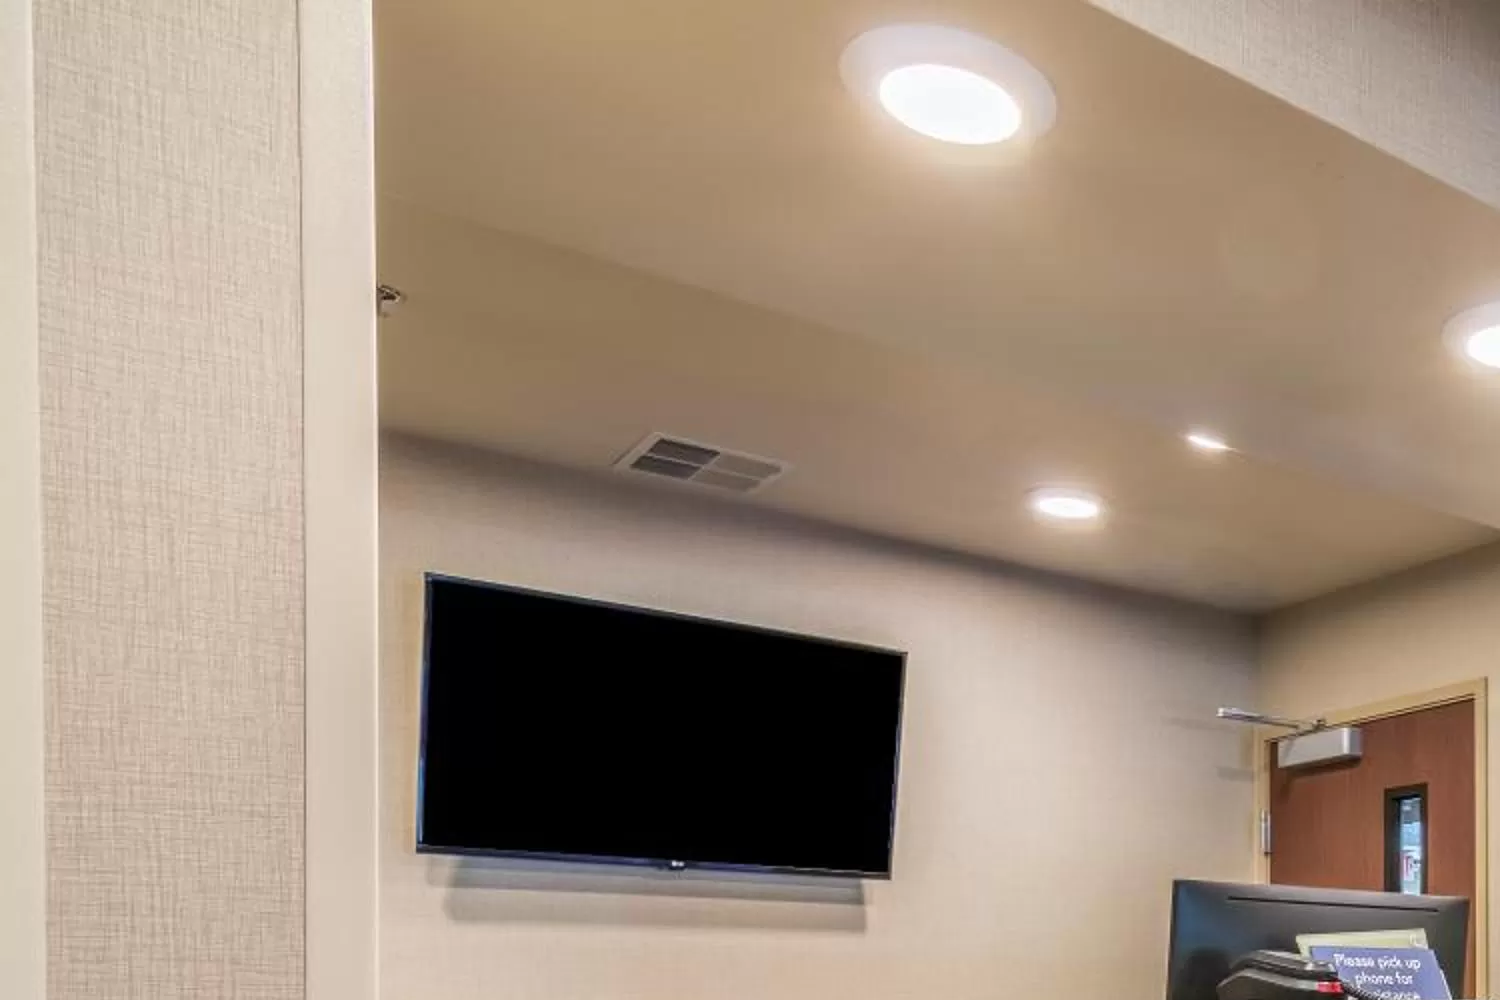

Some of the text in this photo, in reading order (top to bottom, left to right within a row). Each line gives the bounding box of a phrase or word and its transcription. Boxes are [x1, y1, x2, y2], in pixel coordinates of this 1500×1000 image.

[1333, 953, 1422, 973] Please pick up
[1355, 970, 1414, 987] phone for
